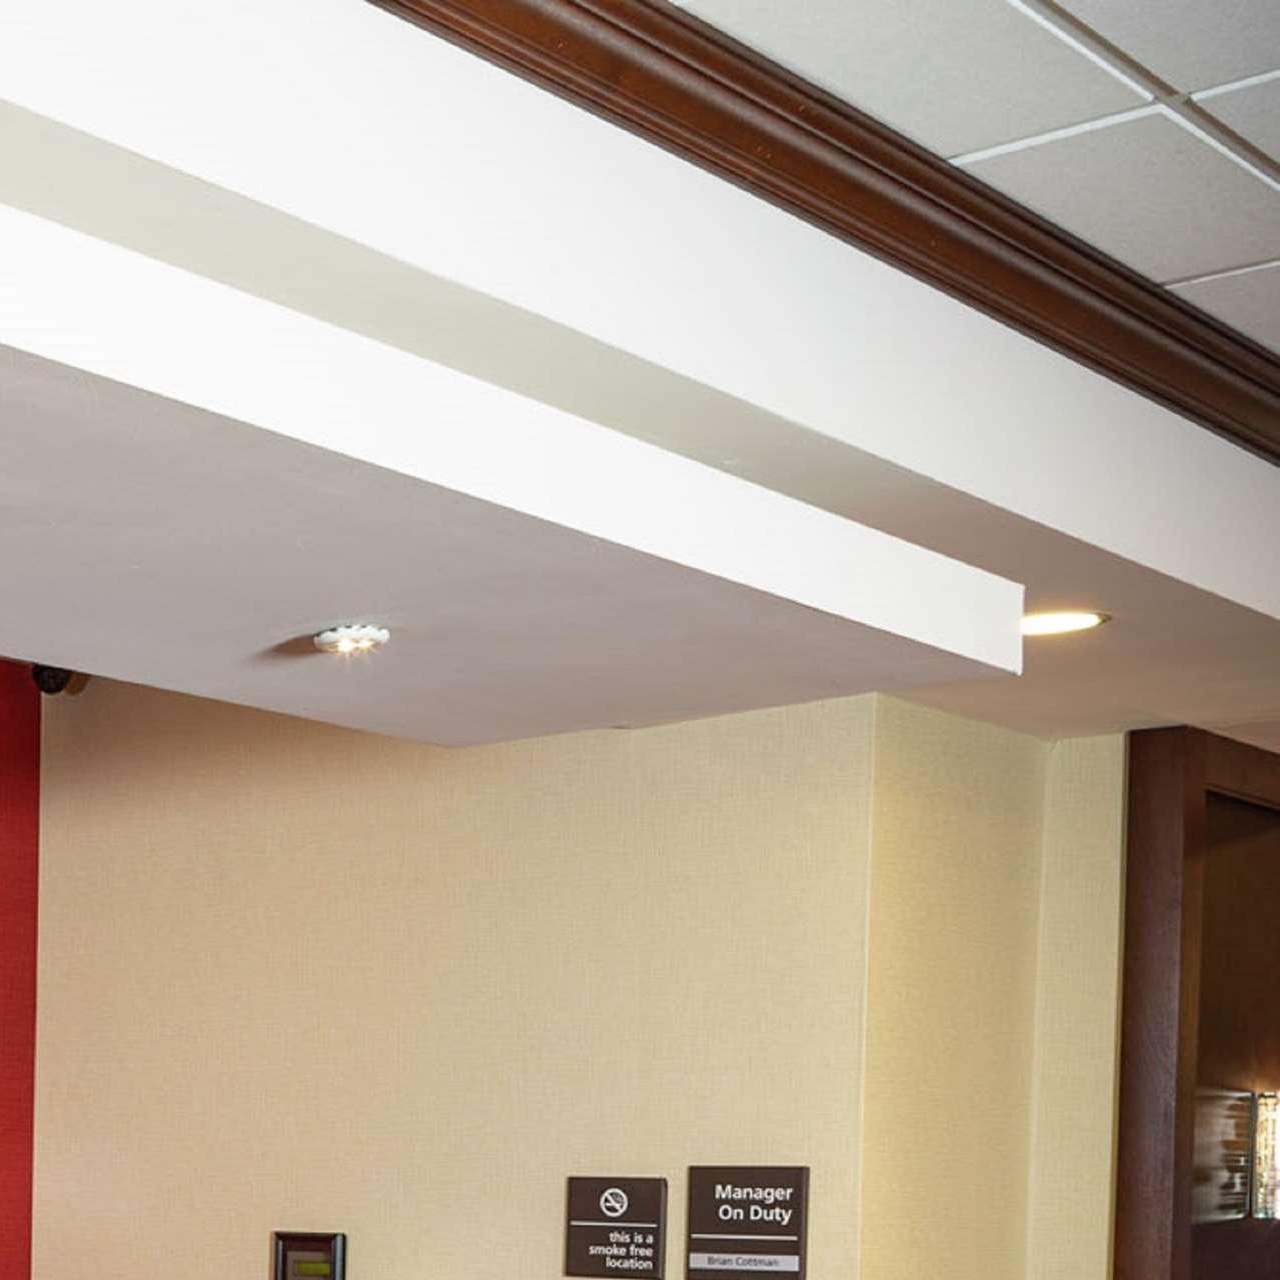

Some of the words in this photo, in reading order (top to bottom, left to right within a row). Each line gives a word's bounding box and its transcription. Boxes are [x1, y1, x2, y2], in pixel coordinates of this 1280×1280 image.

[715, 1184, 793, 1204] Manager
[719, 1205, 744, 1221] On
[749, 1206, 793, 1226] Duty
[609, 1231, 631, 1244] this
[634, 1232, 644, 1244] is
[645, 1235, 654, 1244] a
[589, 1243, 628, 1257] smoke
[629, 1243, 654, 1258] free
[605, 1256, 654, 1271] location
